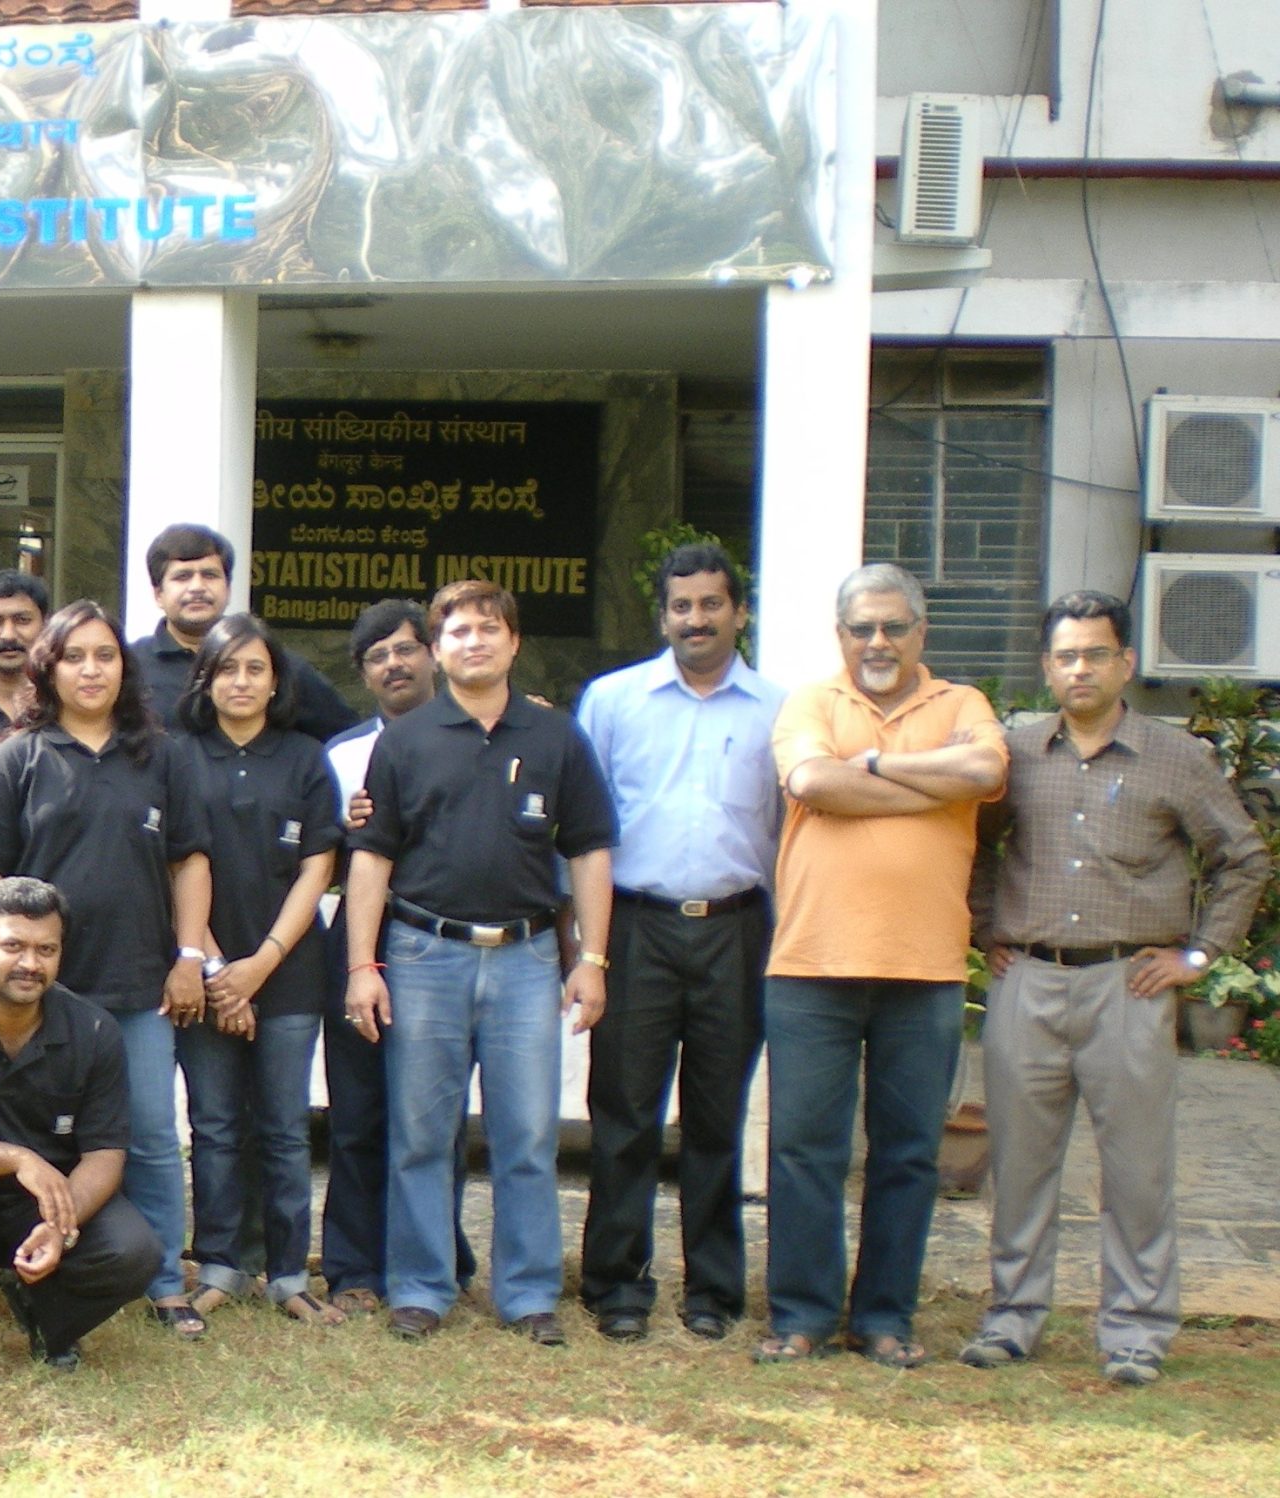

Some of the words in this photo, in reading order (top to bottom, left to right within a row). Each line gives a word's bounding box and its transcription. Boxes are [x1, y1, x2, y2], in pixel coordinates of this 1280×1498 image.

[438, 414, 527, 444] संस्थान
[252, 551, 427, 590] STATISTICAL
[435, 554, 587, 594] INSTITUTE
